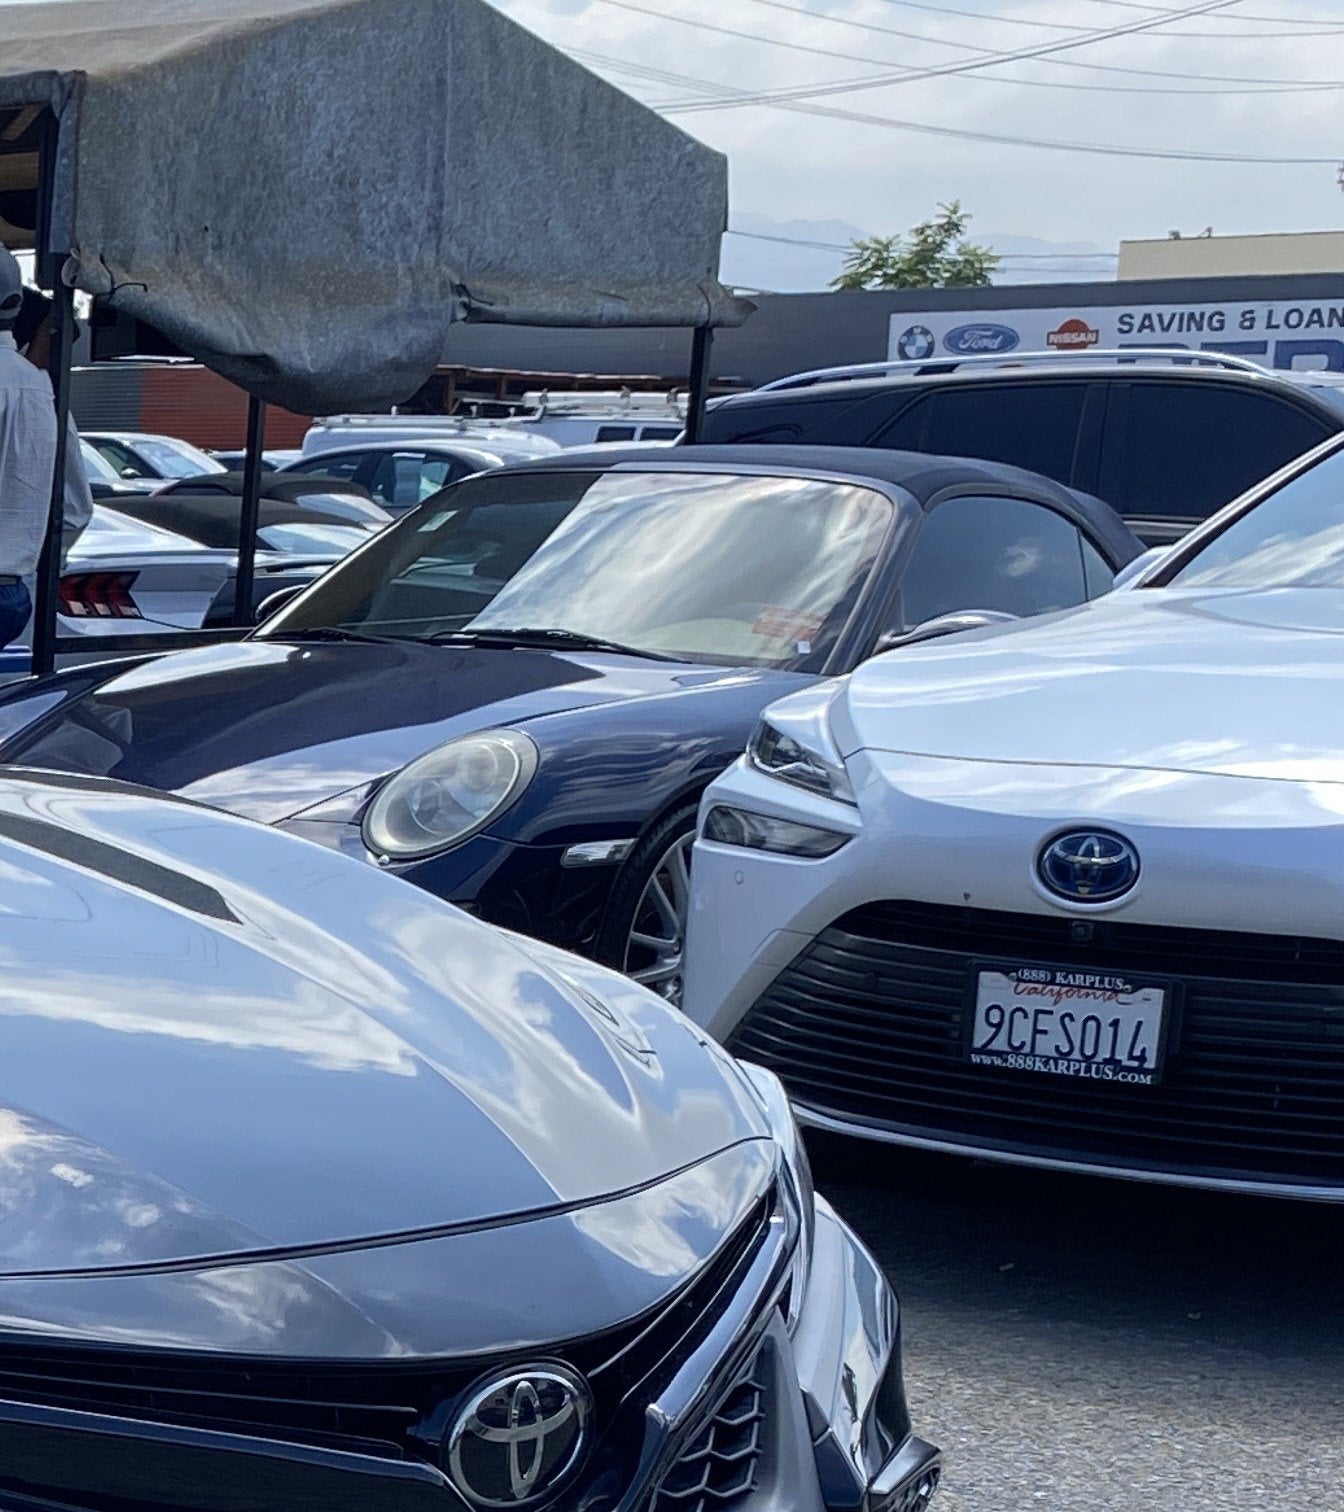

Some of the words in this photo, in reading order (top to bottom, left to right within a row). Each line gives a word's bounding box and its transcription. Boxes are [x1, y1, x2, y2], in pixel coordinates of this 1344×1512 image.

[1117, 310, 1226, 334] SAVING
[1238, 309, 1257, 331] &
[958, 329, 1004, 351] Ford
[1049, 331, 1097, 345] NISSAN
[1017, 968, 1052, 983] (888)
[1055, 971, 1124, 990] KARPLUS
